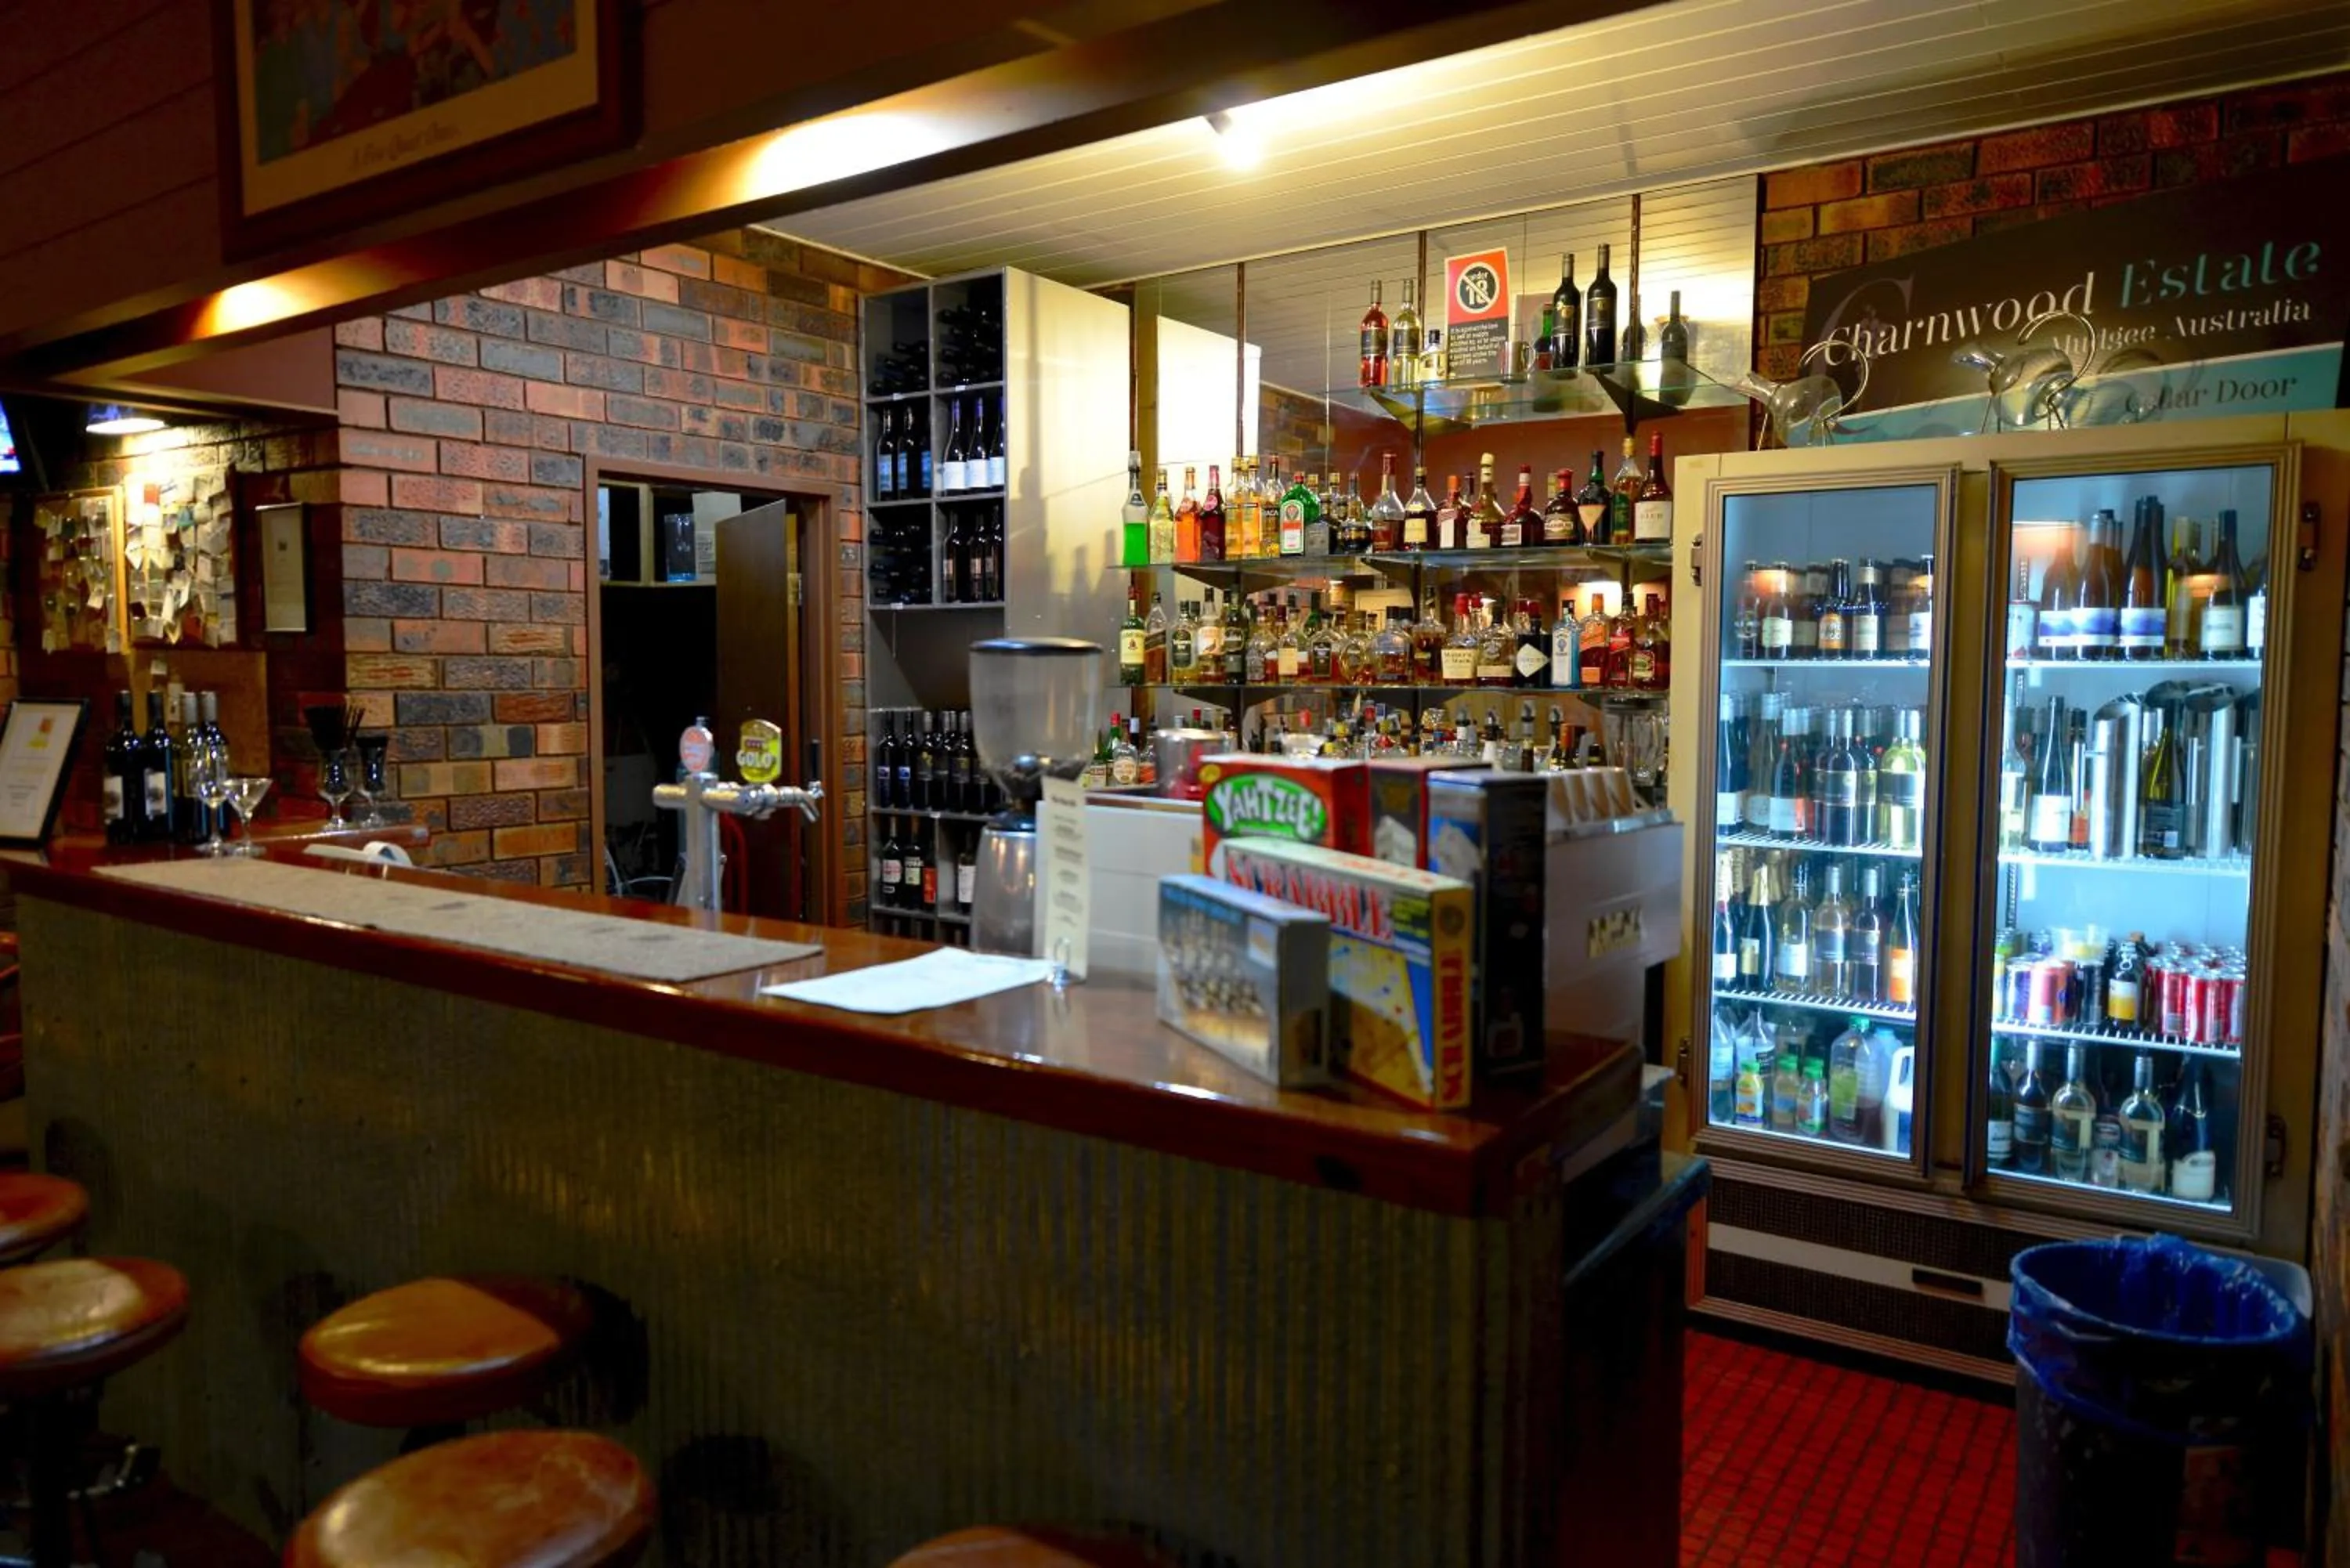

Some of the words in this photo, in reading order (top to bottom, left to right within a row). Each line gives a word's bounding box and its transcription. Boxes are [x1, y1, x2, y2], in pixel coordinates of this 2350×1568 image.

[1466, 280, 1488, 305] 18
[1824, 271, 2095, 367] Charnwood
[2120, 240, 2321, 309] Estate
[2165, 297, 2312, 340] Australia
[2124, 383, 2208, 414] Cllar
[2217, 377, 2298, 404] Door
[736, 750, 773, 769] GOLD
[1213, 775, 1321, 839] YAHTZEE!
